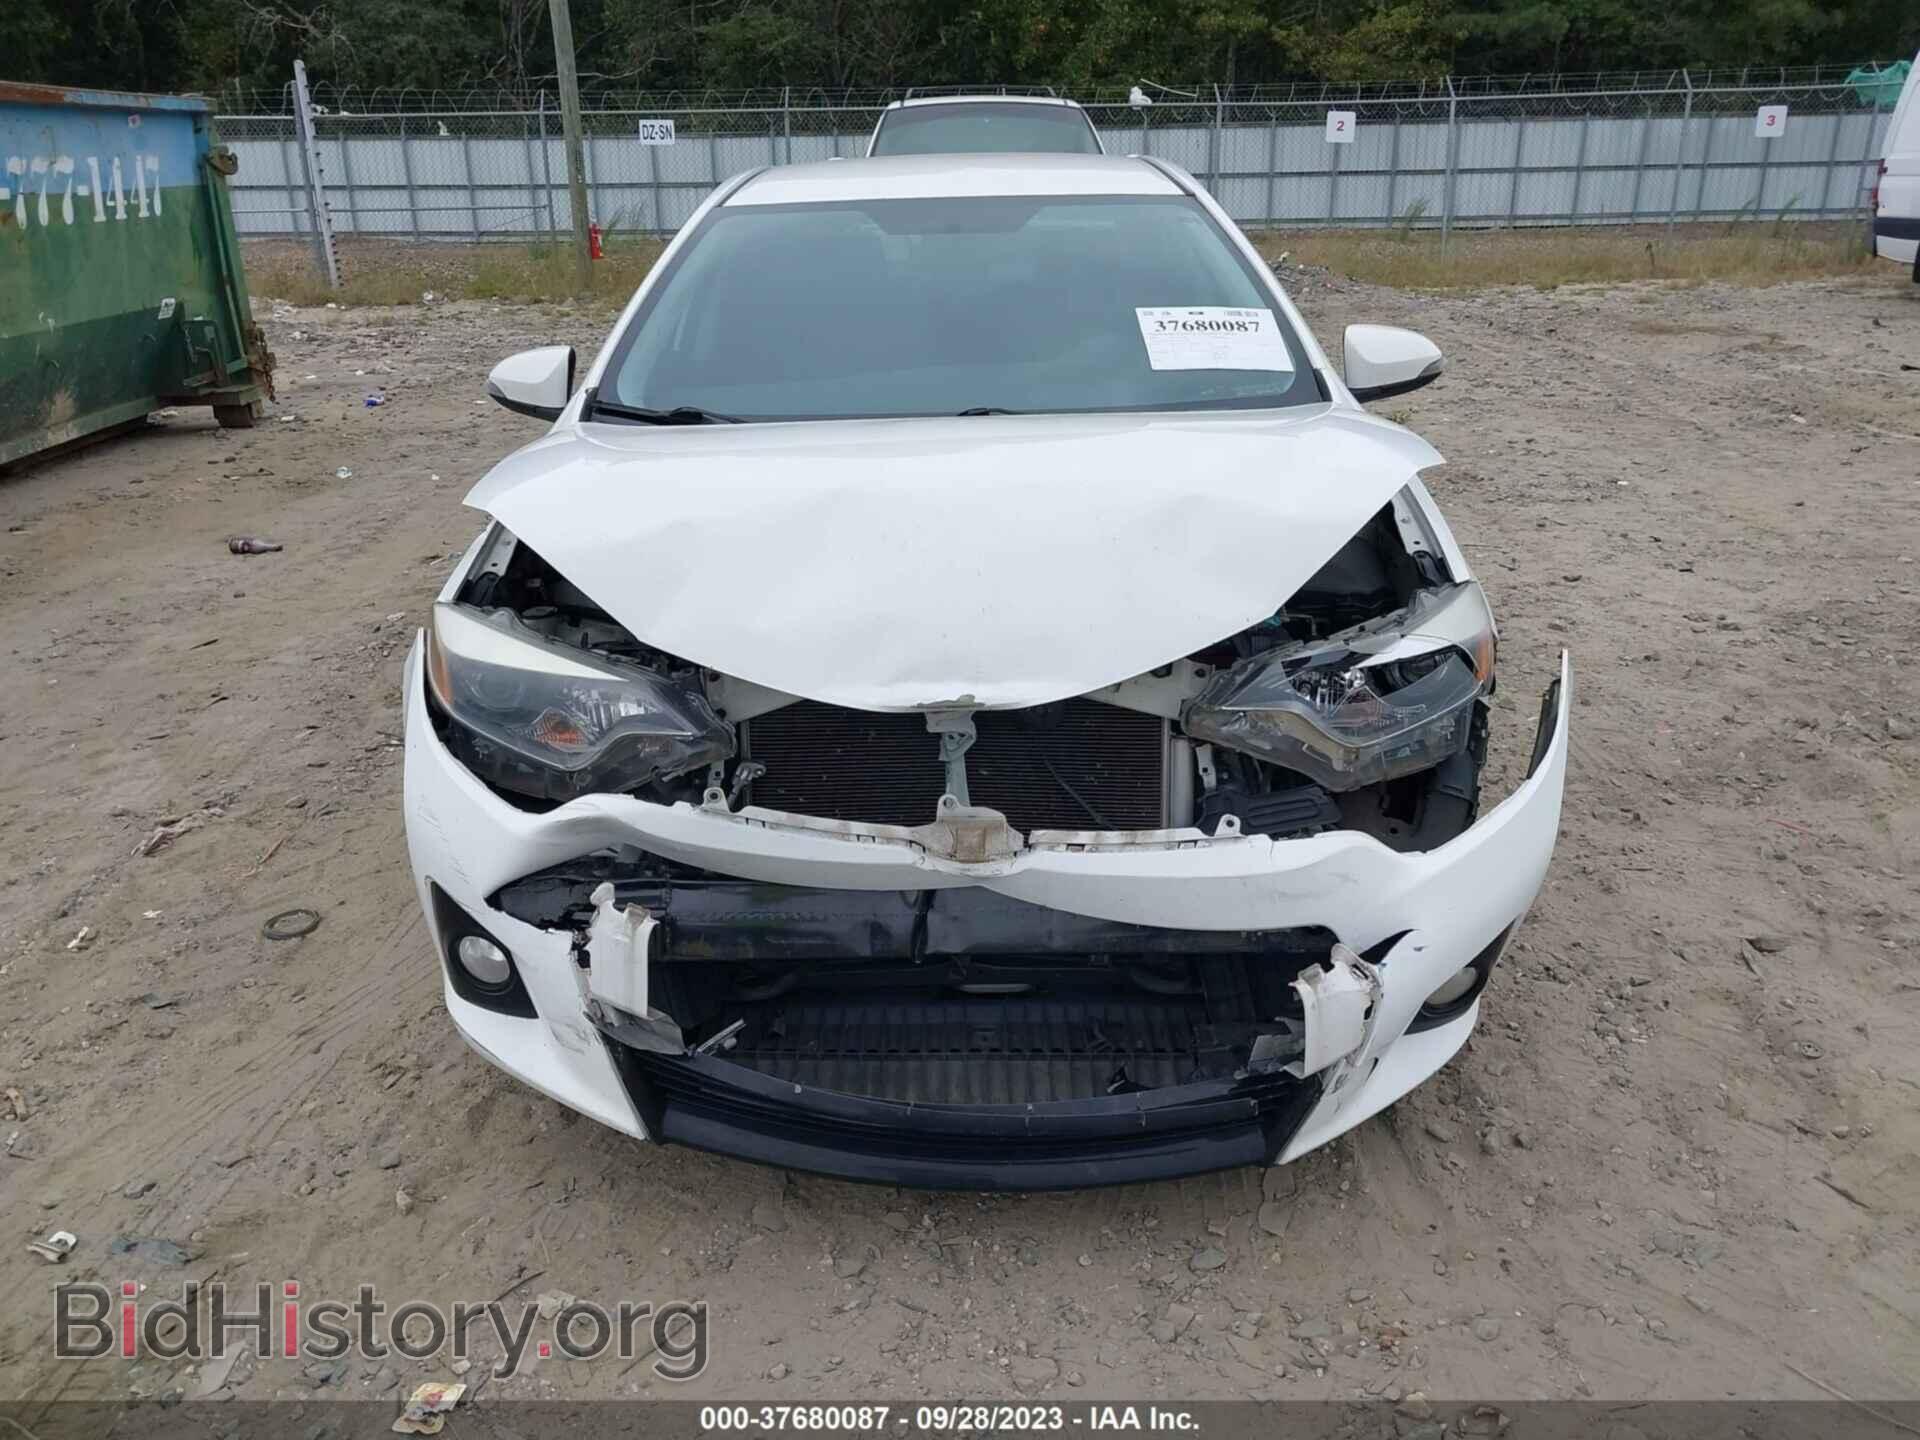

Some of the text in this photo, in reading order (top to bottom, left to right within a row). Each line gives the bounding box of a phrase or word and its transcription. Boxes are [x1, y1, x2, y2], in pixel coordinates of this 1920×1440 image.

[1336, 120, 1345, 132] 2
[1766, 114, 1776, 127] 3
[642, 124, 672, 140] DZ-SN
[1154, 320, 1260, 333] 37680087
